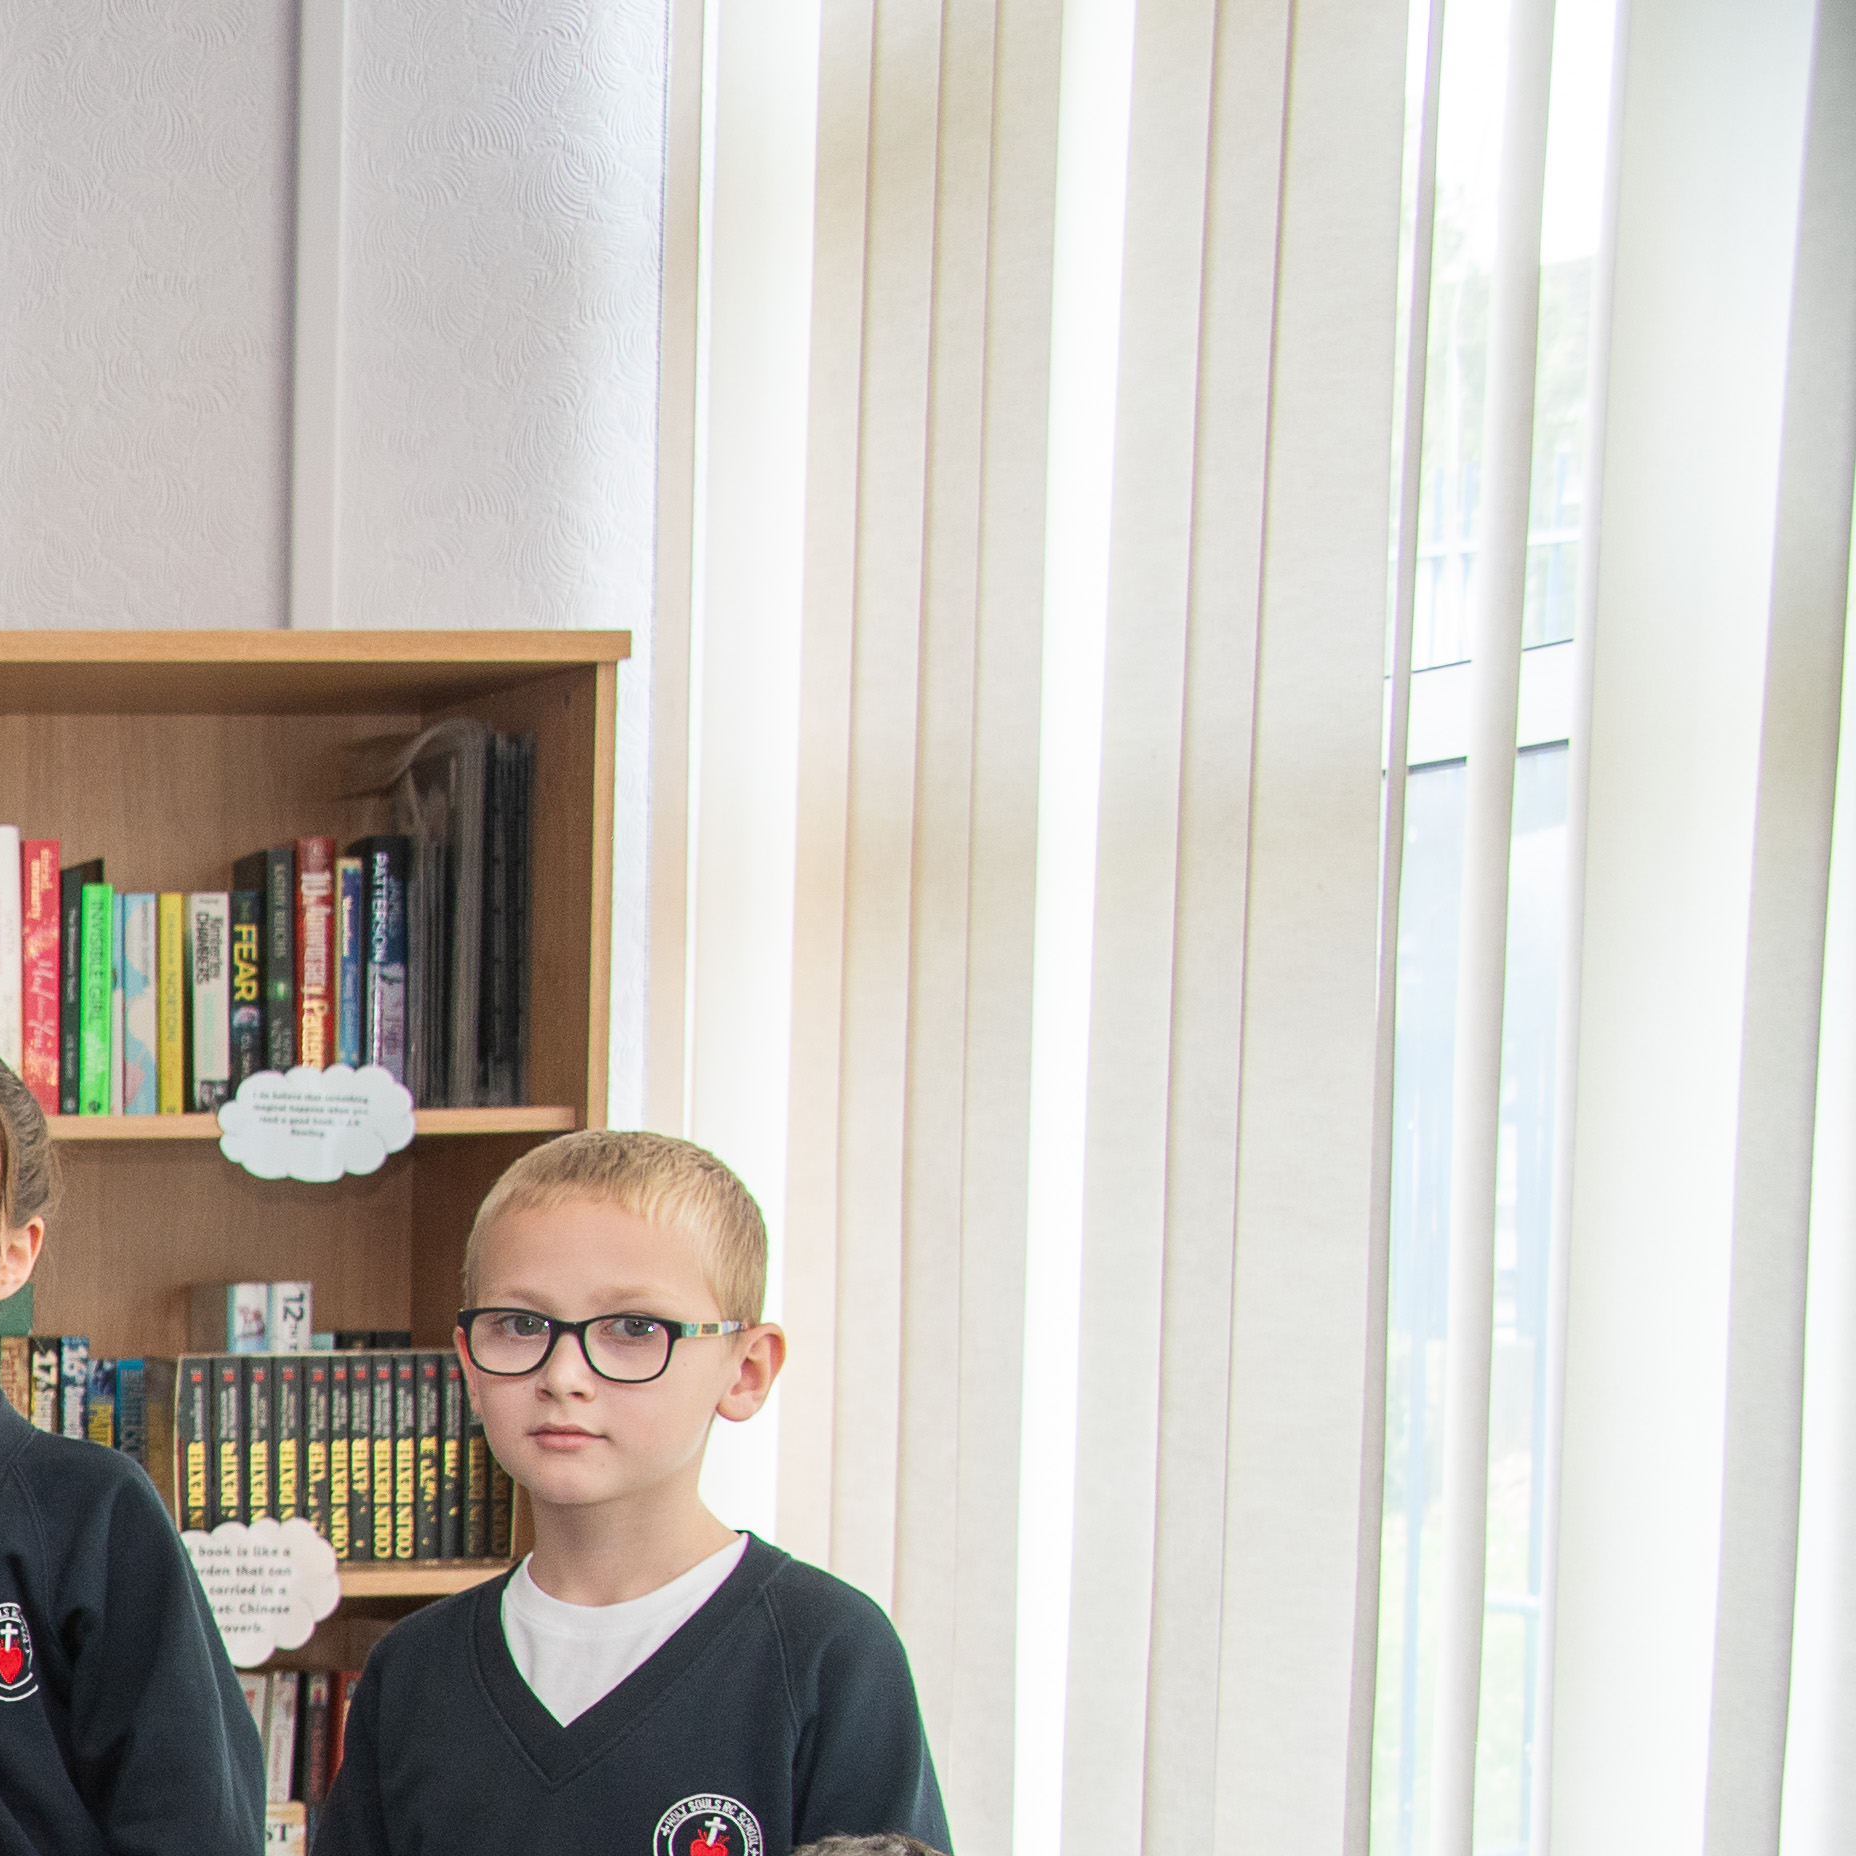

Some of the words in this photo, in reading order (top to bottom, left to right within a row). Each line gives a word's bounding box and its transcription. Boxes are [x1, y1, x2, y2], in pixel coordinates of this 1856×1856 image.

[371, 850, 390, 962] PATTERSON
[89, 901, 105, 979] INVISIBLE
[233, 923, 259, 1001] FEAR
[88, 984, 104, 1024] GIRL
[165, 970, 178, 1043] NORTON
[188, 1440, 206, 1507] DEXTER
[250, 1440, 268, 1507] DEXTER
[279, 1438, 297, 1506] DEXTER
[331, 1438, 349, 1505] DEXTER
[373, 1438, 392, 1504] DEXTER
[396, 1438, 415, 1504] DEXTER
[198, 1545, 233, 1557] book
[237, 1546, 249, 1557] is
[253, 1545, 278, 1557] like
[374, 1503, 392, 1559] COLIN
[396, 1503, 414, 1559] COLIN
[197, 1565, 230, 1576] rden
[236, 1566, 264, 1576] that
[268, 1567, 292, 1576] can
[208, 1584, 257, 1595] carried
[261, 1584, 273, 1595] in
[218, 1622, 264, 1634] roverb.
[239, 1601, 291, 1615] Chinese
